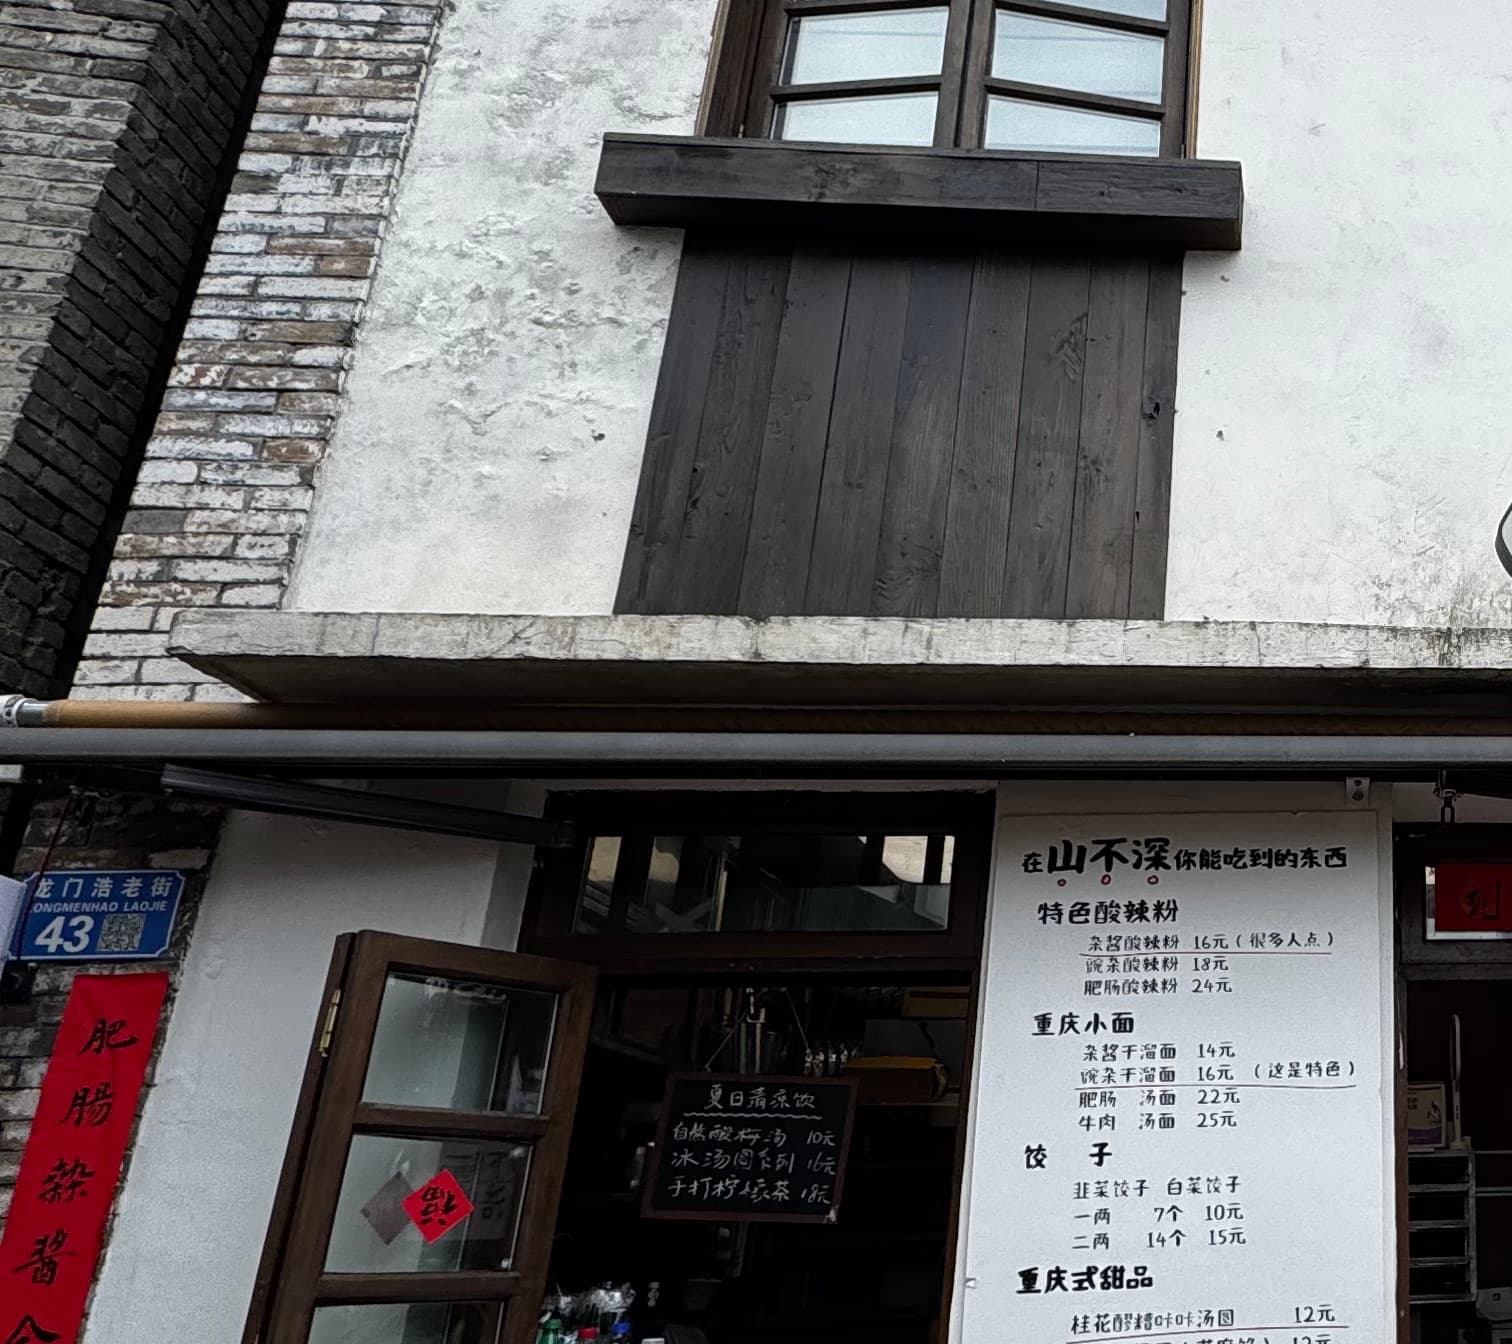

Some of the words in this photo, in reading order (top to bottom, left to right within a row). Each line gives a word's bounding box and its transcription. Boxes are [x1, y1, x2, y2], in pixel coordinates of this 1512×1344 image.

[1022, 837, 1348, 875] 在山不深你能吃到的东西
[35, 876, 174, 899] 龙门浩老街
[30, 902, 119, 914] ONGMENHAO
[123, 900, 169, 913] LAOJIE
[1037, 898, 1179, 925] 特色酸辣粉
[35, 914, 95, 954] 43
[1087, 933, 1180, 953] 杂酱酸辣粉
[1191, 955, 1229, 972] 18元
[1083, 976, 1178, 996] 肥肠酸辣粉
[1191, 976, 1232, 994] 24元
[1031, 1011, 1135, 1037] 重庆小面
[1197, 1041, 1236, 1059] 14元
[1197, 1064, 1235, 1082] 16元
[703, 1083, 816, 1110] 夏日清凉饮
[1078, 1090, 1117, 1109] 肥肠
[1138, 1089, 1176, 1107] 汤面
[1196, 1087, 1241, 1105] 22元
[1078, 1113, 1116, 1132] 牛肉
[1138, 1112, 1176, 1131] 汤面
[1196, 1110, 1238, 1128] 25元
[806, 1129, 836, 1147] 10元
[1072, 1179, 1150, 1200] 韭菜饺子
[1166, 1175, 1242, 1197] 白菜饺子
[420, 1185, 458, 1227] 福
[1073, 1207, 1111, 1225] 一两
[1153, 1204, 1184, 1223] 7个
[1204, 1202, 1244, 1222] 10元
[1071, 1231, 1110, 1251] 二两
[1146, 1228, 1187, 1249] 14个
[1207, 1226, 1247, 1246] 15元
[1015, 1264, 1154, 1295] 重庆式甜品
[1294, 1303, 1336, 1325] 12元
